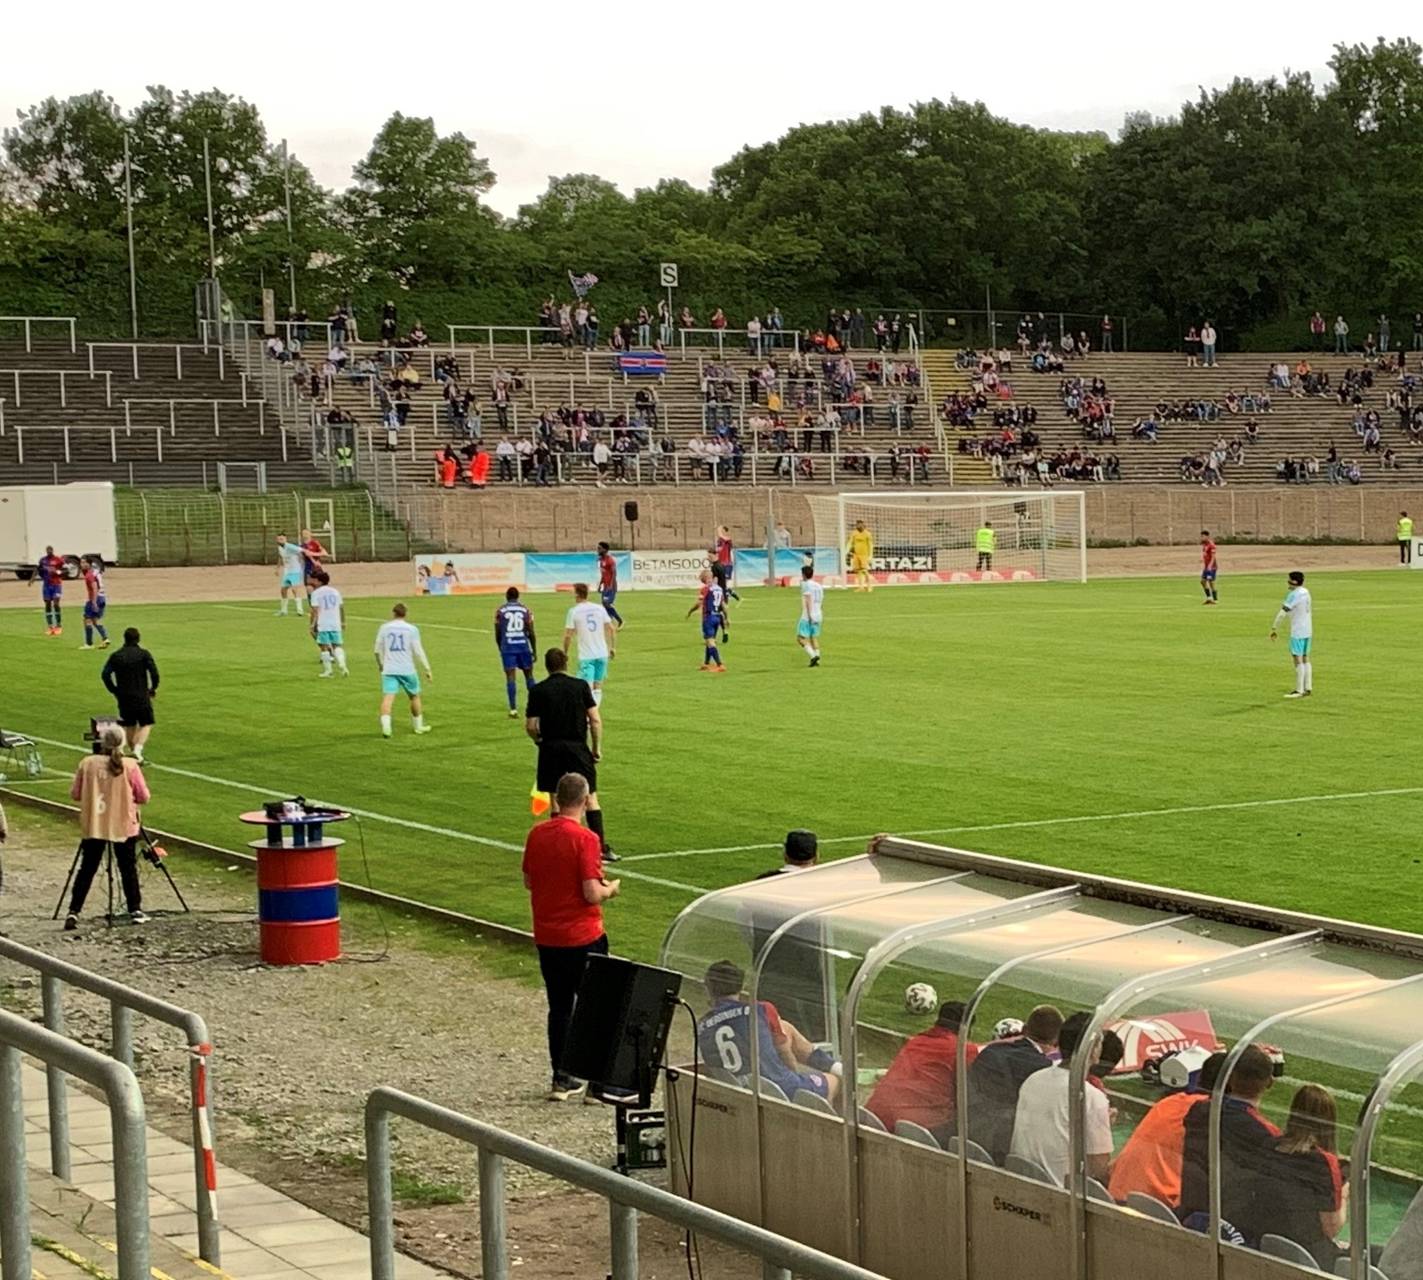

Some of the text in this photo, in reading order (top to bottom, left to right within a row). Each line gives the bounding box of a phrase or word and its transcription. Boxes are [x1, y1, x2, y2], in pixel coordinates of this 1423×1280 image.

[663, 266, 676, 284] S
[633, 559, 711, 570] BETAISODO
[323, 595, 336, 609] 19
[504, 611, 524, 631] 26
[586, 614, 597, 632] 5
[387, 632, 405, 651] 21
[95, 793, 106, 815] 6
[715, 1025, 743, 1073] 6
